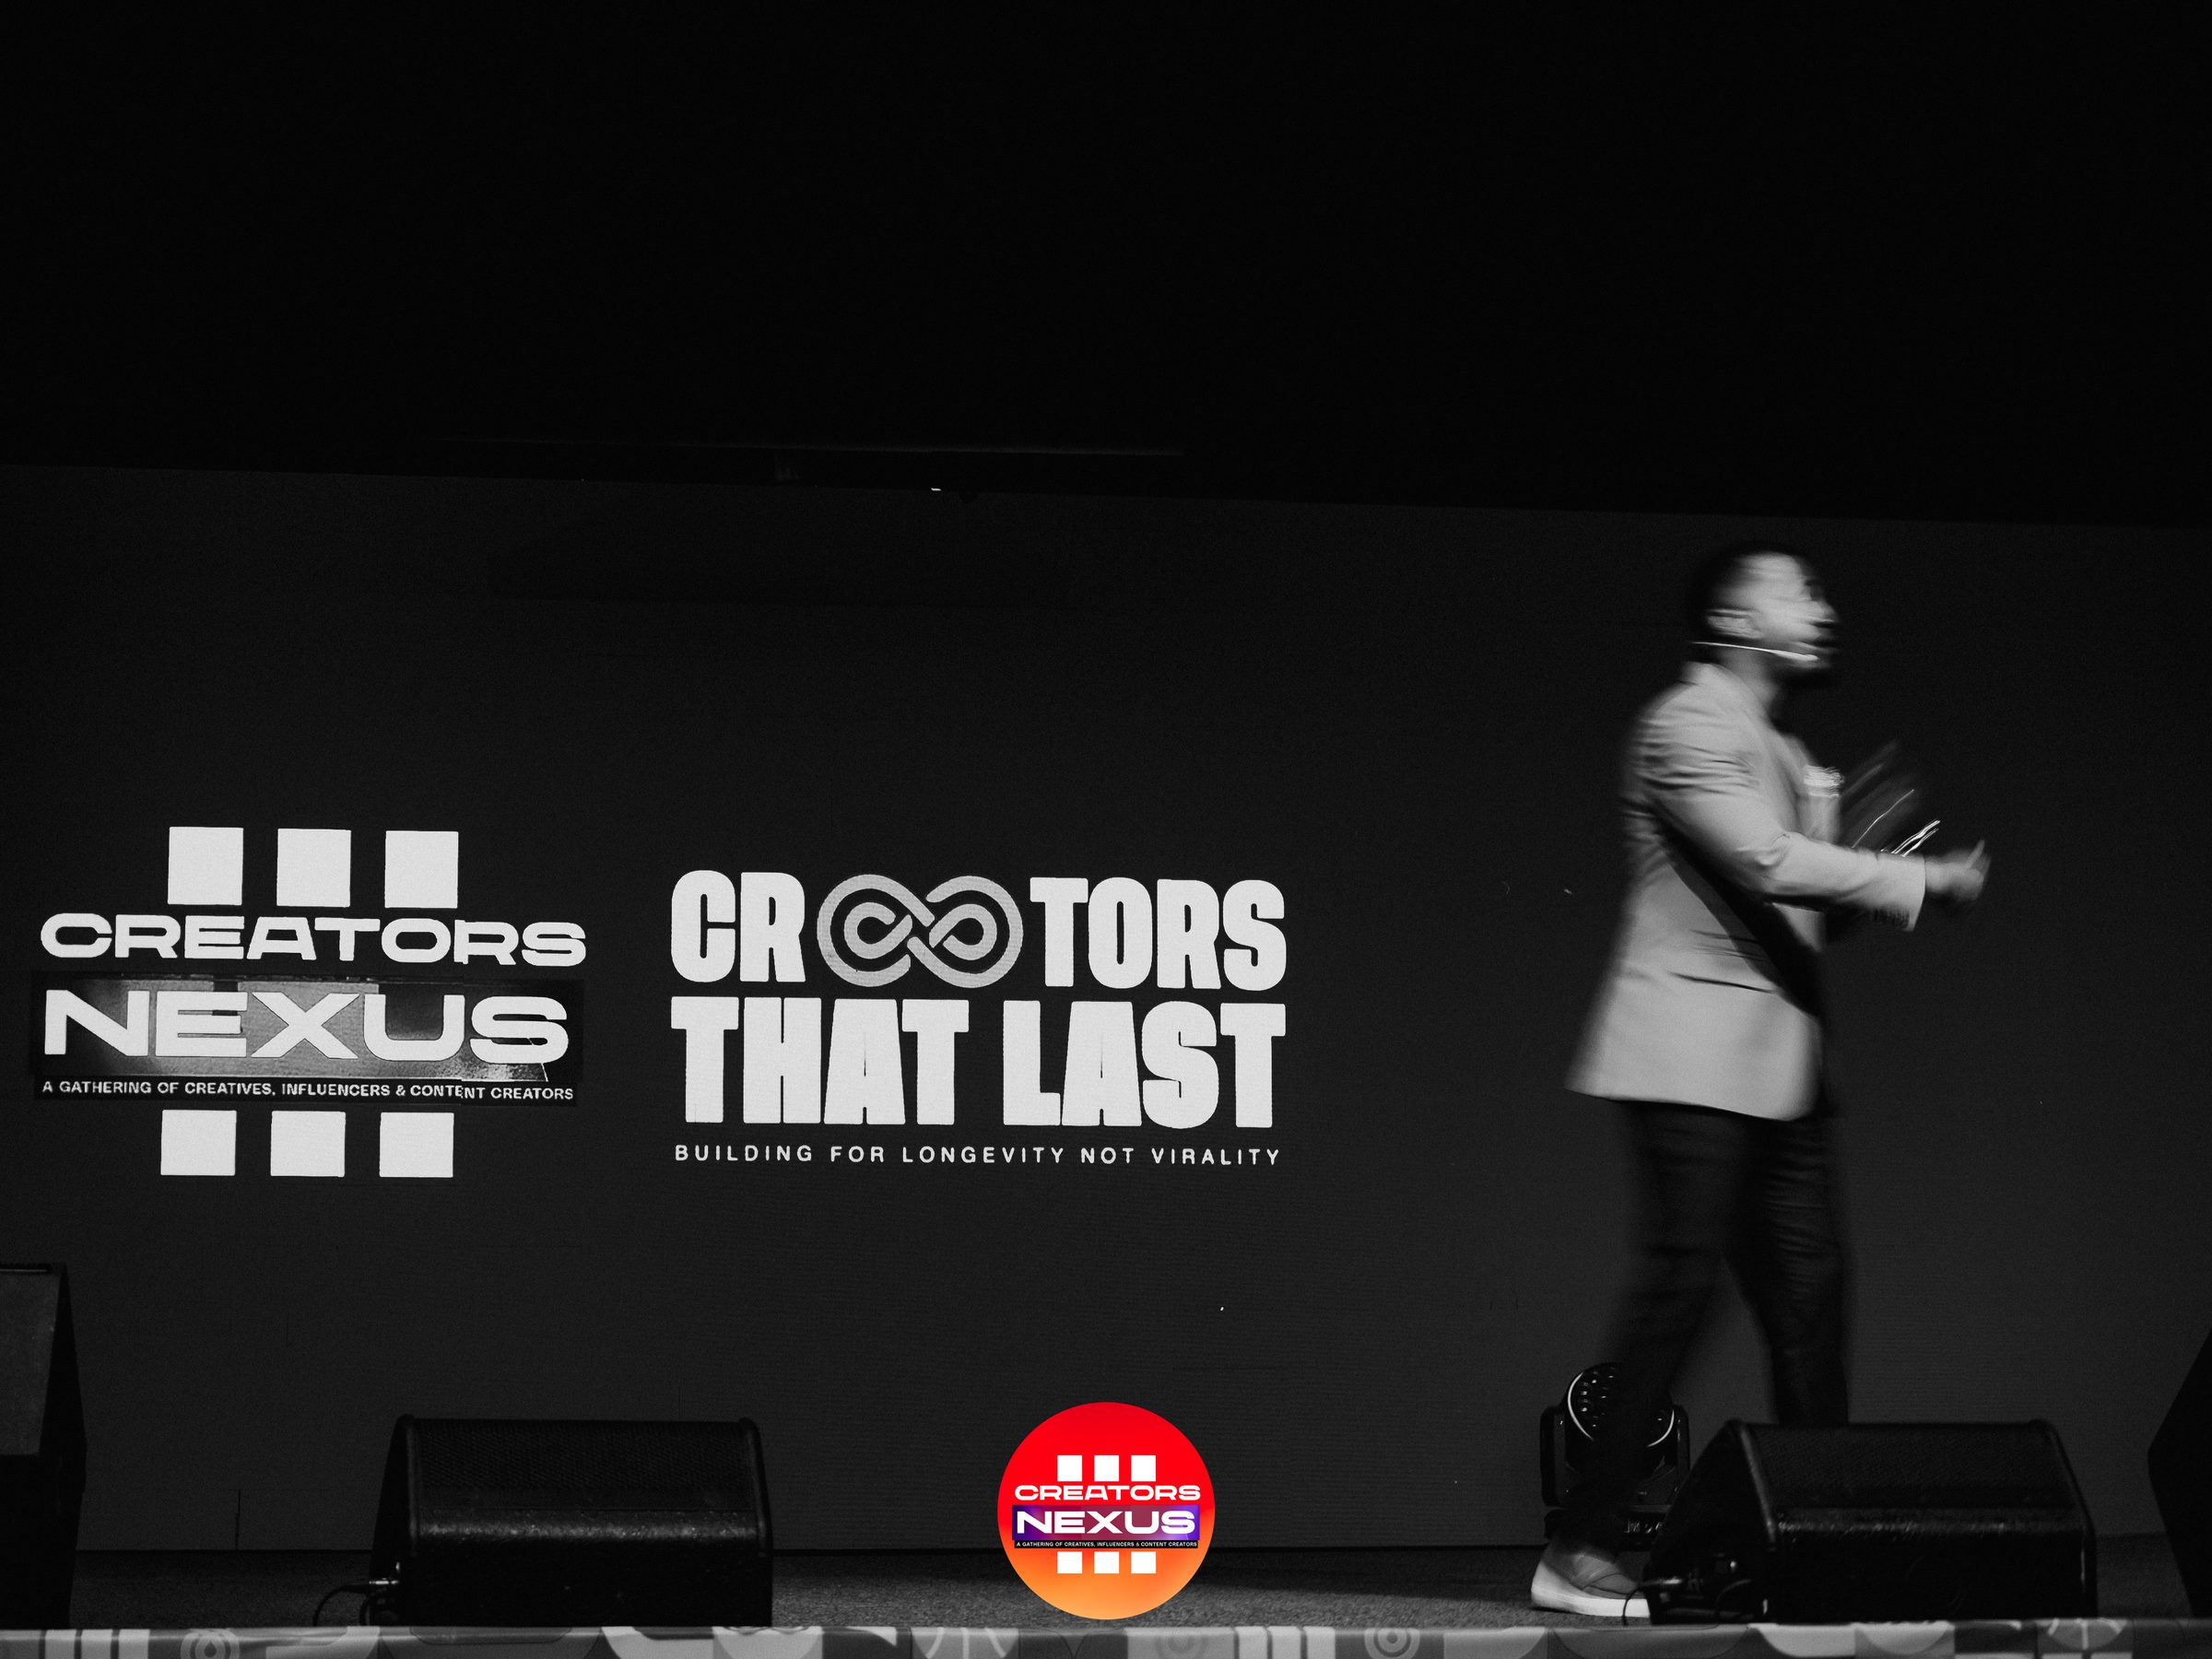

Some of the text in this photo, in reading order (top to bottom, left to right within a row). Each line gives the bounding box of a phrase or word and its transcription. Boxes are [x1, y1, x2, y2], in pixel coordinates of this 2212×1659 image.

[41, 913, 586, 966] CREATORS
[44, 990, 570, 1065] NEXUS
[671, 996, 1286, 1129] THAT LAST
[42, 1081, 573, 1100] A GATHERING OF CREATIVES, INFLUENCERS & CONTENT CREATORS
[676, 1145, 1278, 1165] BUILDING FOR LONGEVITY NOT VIRALITY
